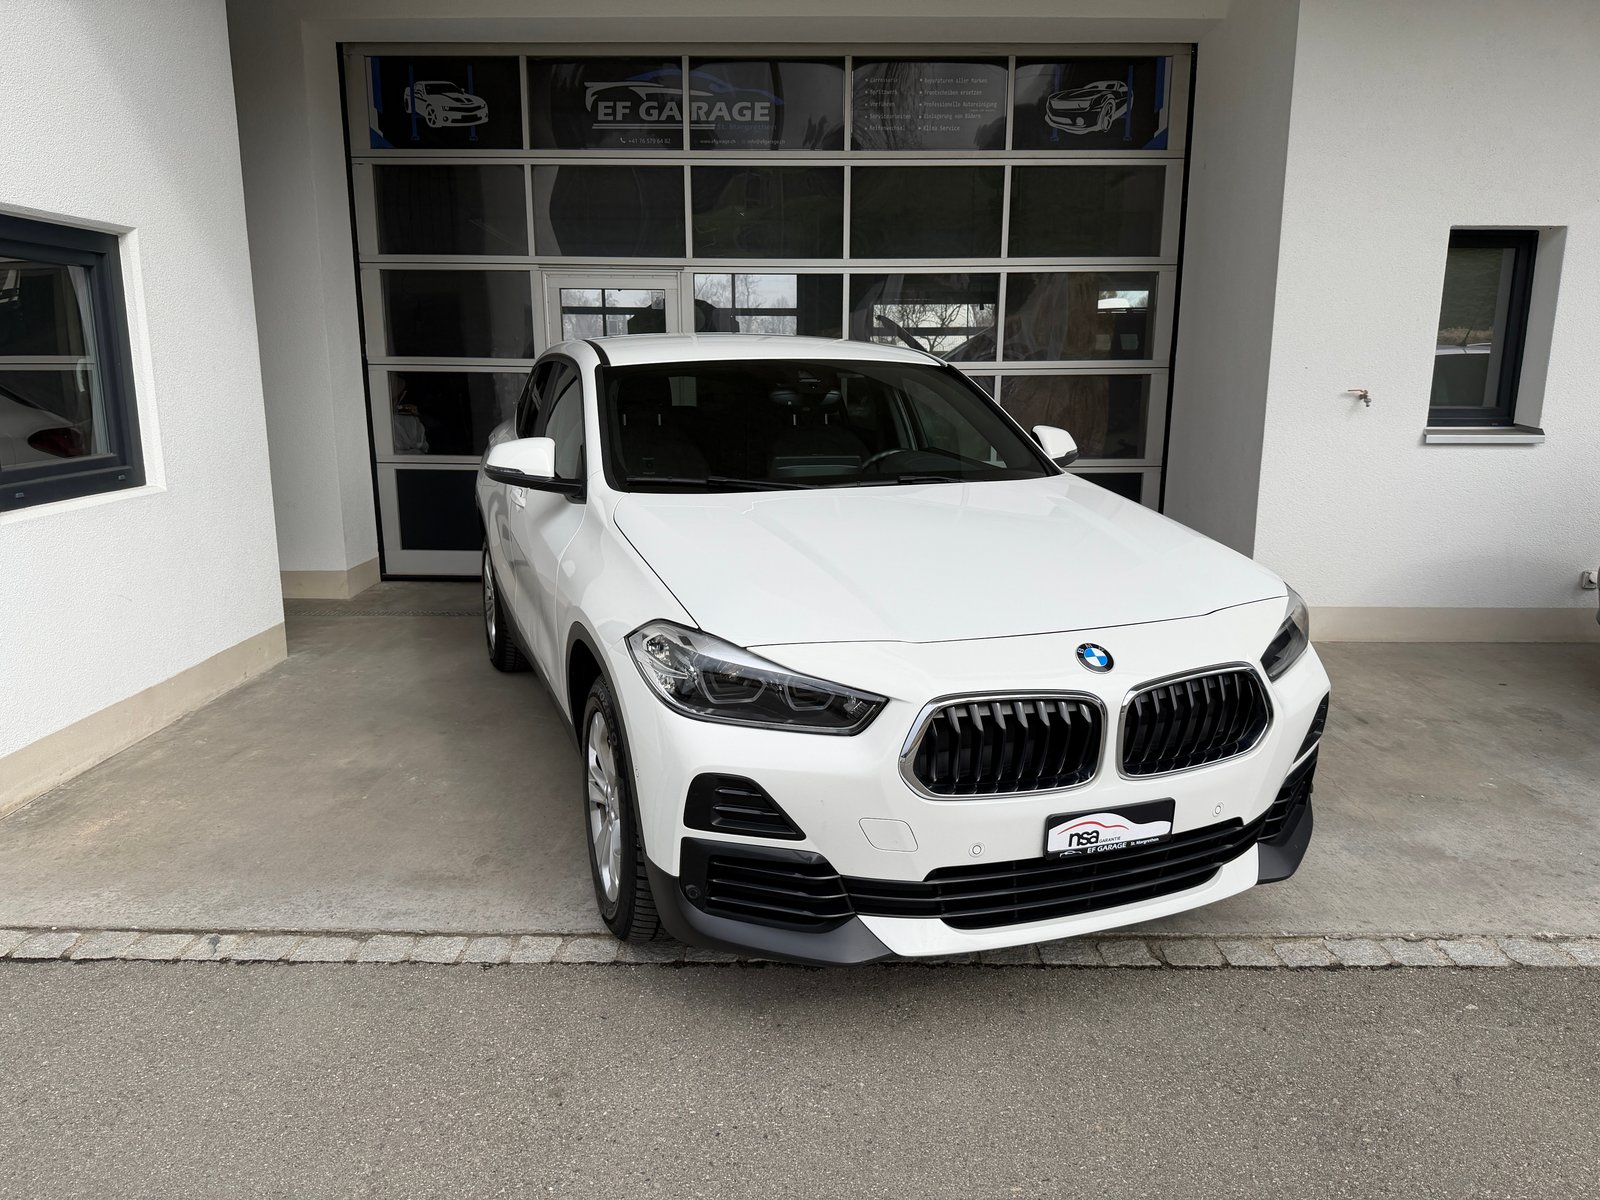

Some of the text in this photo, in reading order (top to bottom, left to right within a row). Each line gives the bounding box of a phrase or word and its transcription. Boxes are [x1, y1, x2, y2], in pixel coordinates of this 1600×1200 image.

[597, 101, 771, 121] EF GARAGE
[1068, 830, 1099, 847] nsa
[1087, 846, 1097, 854] EF
[1097, 841, 1127, 852] GARAGE
